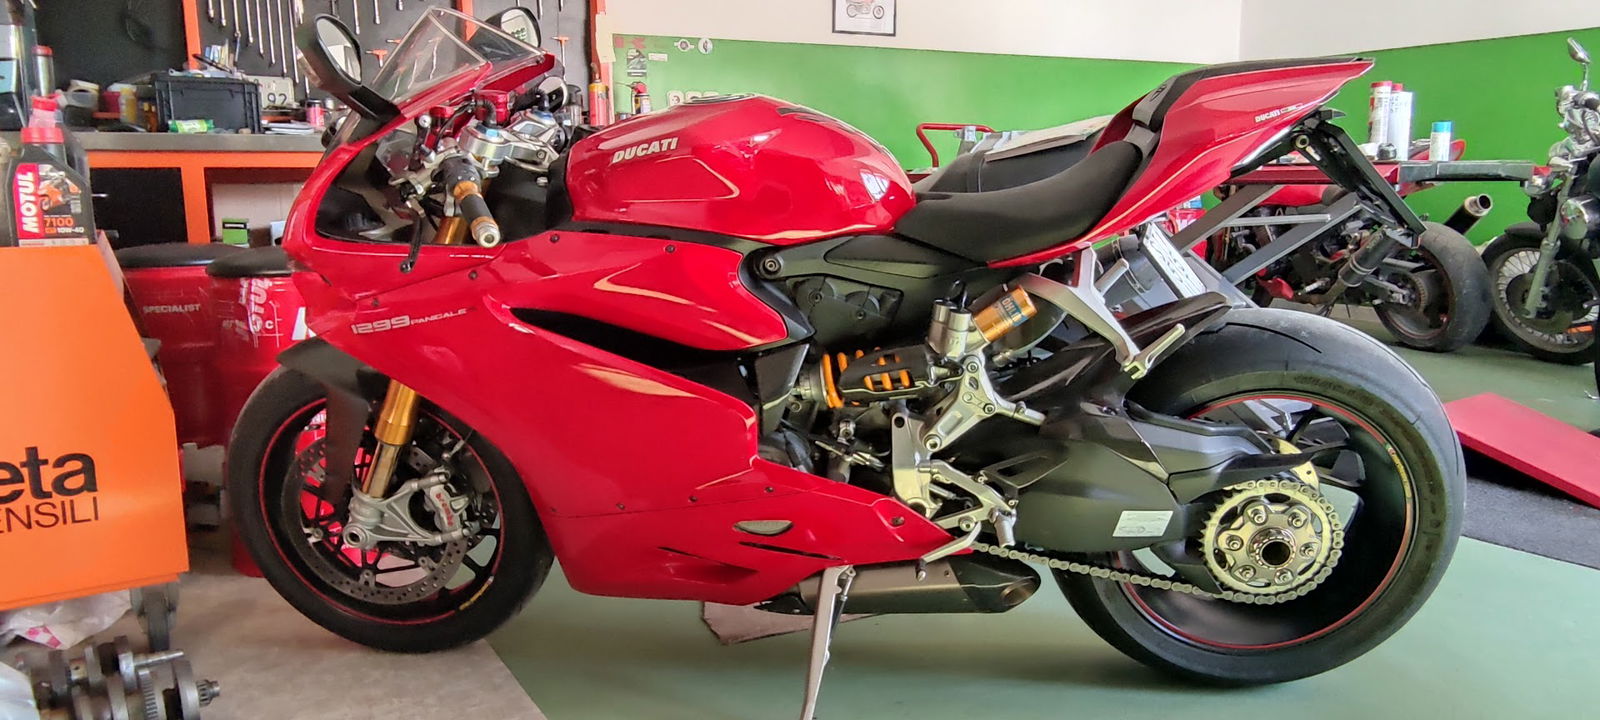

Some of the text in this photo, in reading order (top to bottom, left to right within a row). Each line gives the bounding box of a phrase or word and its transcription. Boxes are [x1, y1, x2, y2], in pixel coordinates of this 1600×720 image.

[1254, 109, 1281, 123] DUCATI
[612, 137, 679, 164] DUCATI
[17, 171, 39, 233] MOTUL
[44, 216, 74, 228] 7100
[143, 303, 201, 314] SPECIALIST
[350, 314, 411, 335] 1299
[0, 496, 100, 534] NSILI
